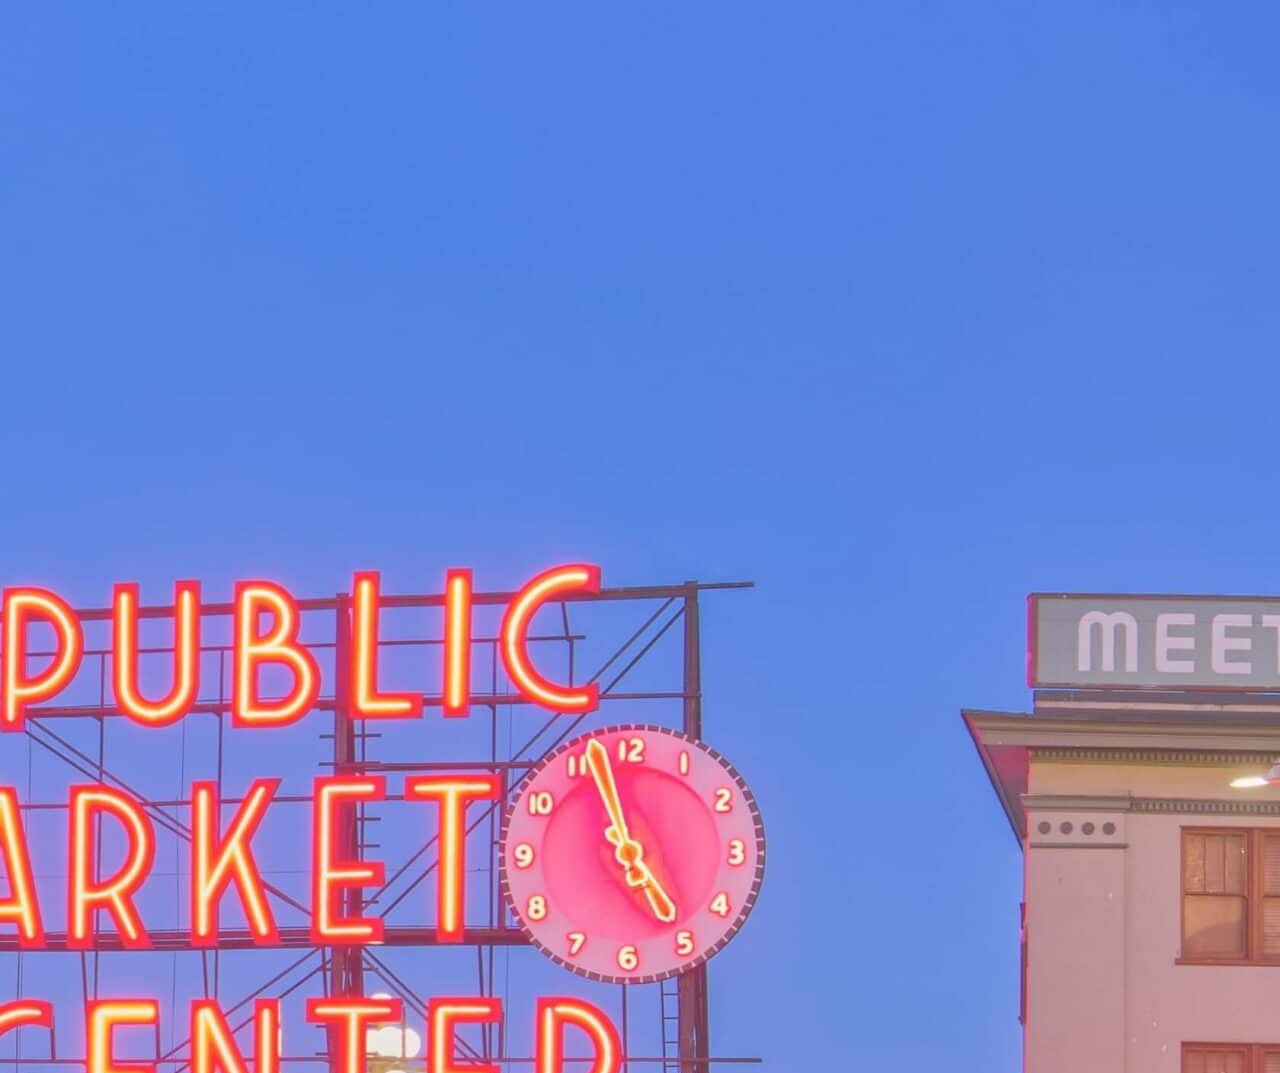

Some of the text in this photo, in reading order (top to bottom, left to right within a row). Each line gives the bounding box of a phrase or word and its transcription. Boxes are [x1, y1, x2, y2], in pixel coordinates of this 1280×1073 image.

[0, 563, 601, 733] PUBLIC
[618, 739, 645, 762] 12
[568, 755, 587, 777] 11
[679, 752, 689, 774] 1
[529, 792, 553, 815] 10
[715, 789, 731, 812] 2
[514, 844, 533, 867] 9
[728, 840, 745, 865] 3
[528, 896, 546, 919] 8
[711, 893, 729, 916] 4
[568, 933, 585, 955] 7
[677, 932, 693, 955] 5
[618, 946, 638, 970] 6
